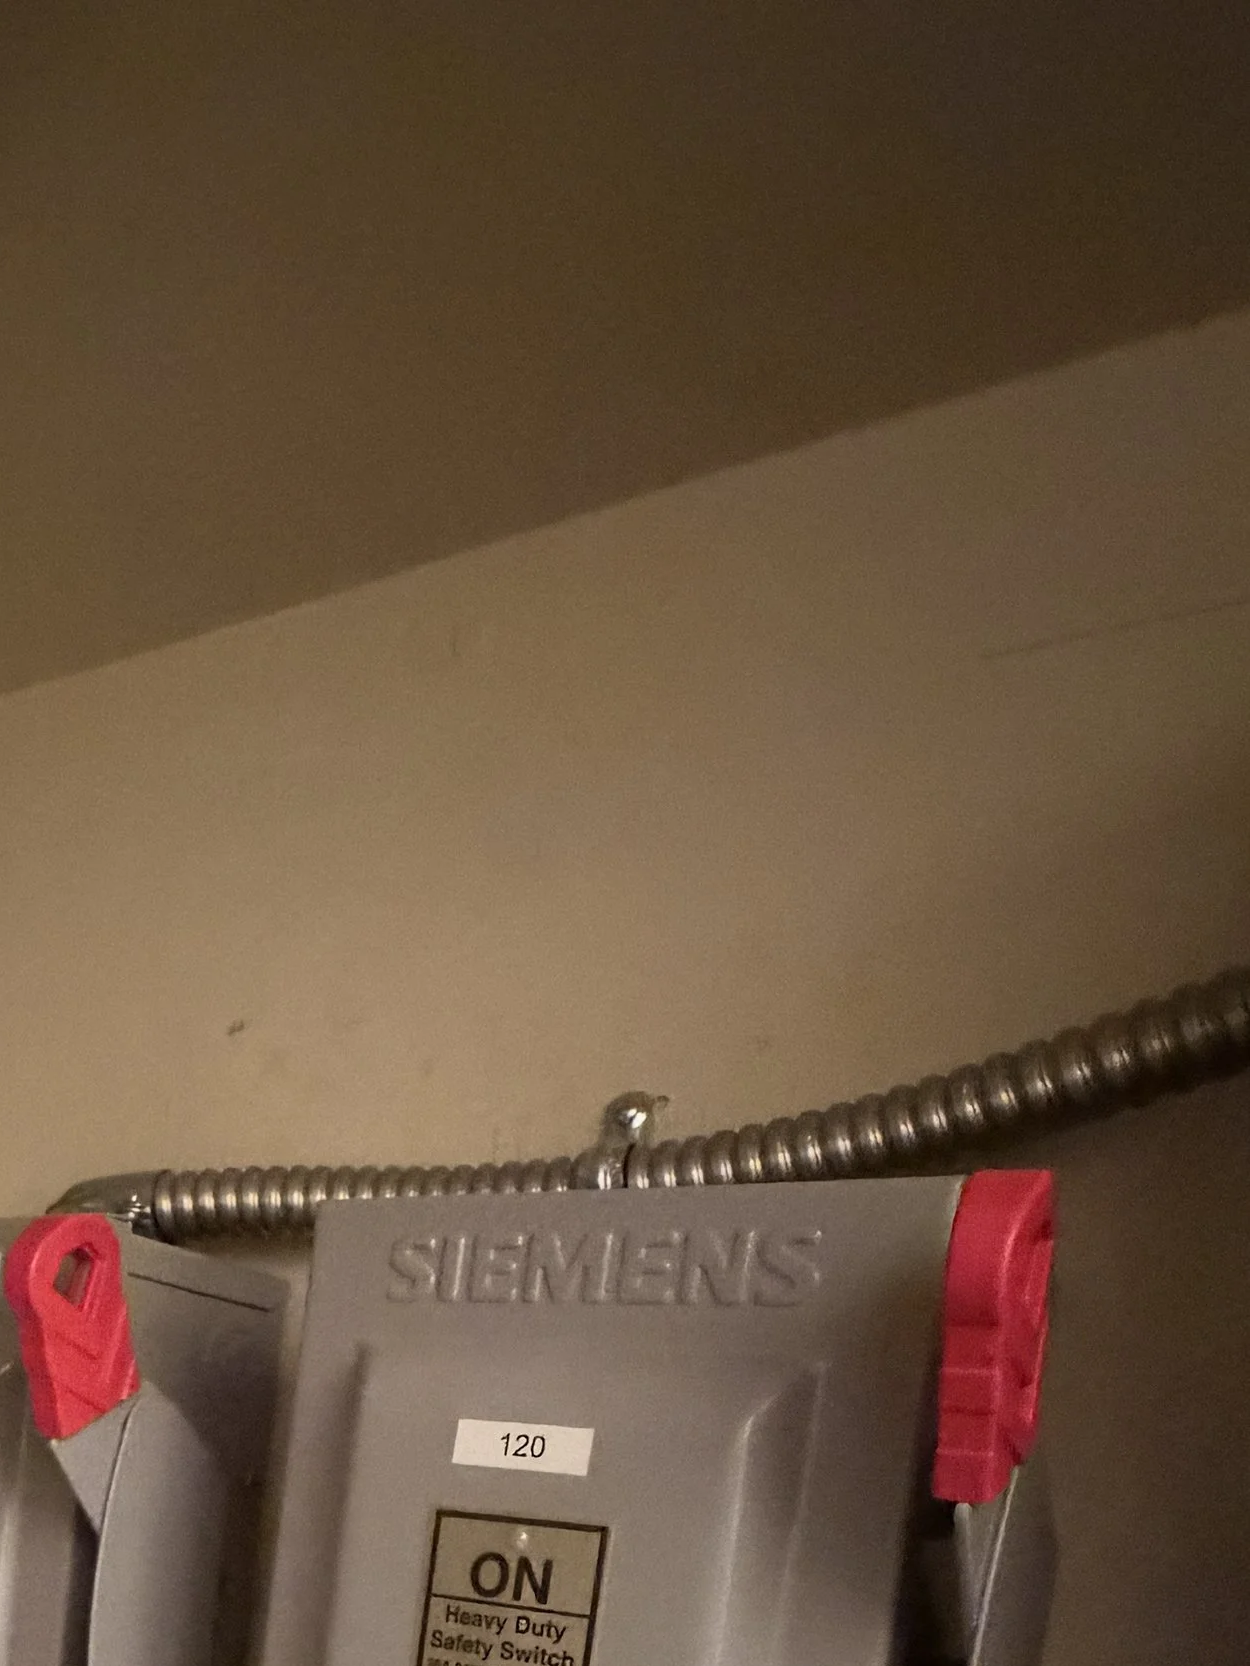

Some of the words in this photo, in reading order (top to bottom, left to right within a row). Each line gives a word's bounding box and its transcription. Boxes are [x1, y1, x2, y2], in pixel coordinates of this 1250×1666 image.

[387, 1229, 822, 1307] SIEMENS
[500, 1432, 546, 1459] 120
[470, 1551, 554, 1605] ON
[430, 1629, 494, 1661] Safety
[445, 1604, 509, 1636] Heavy
[515, 1615, 567, 1645] Duty
